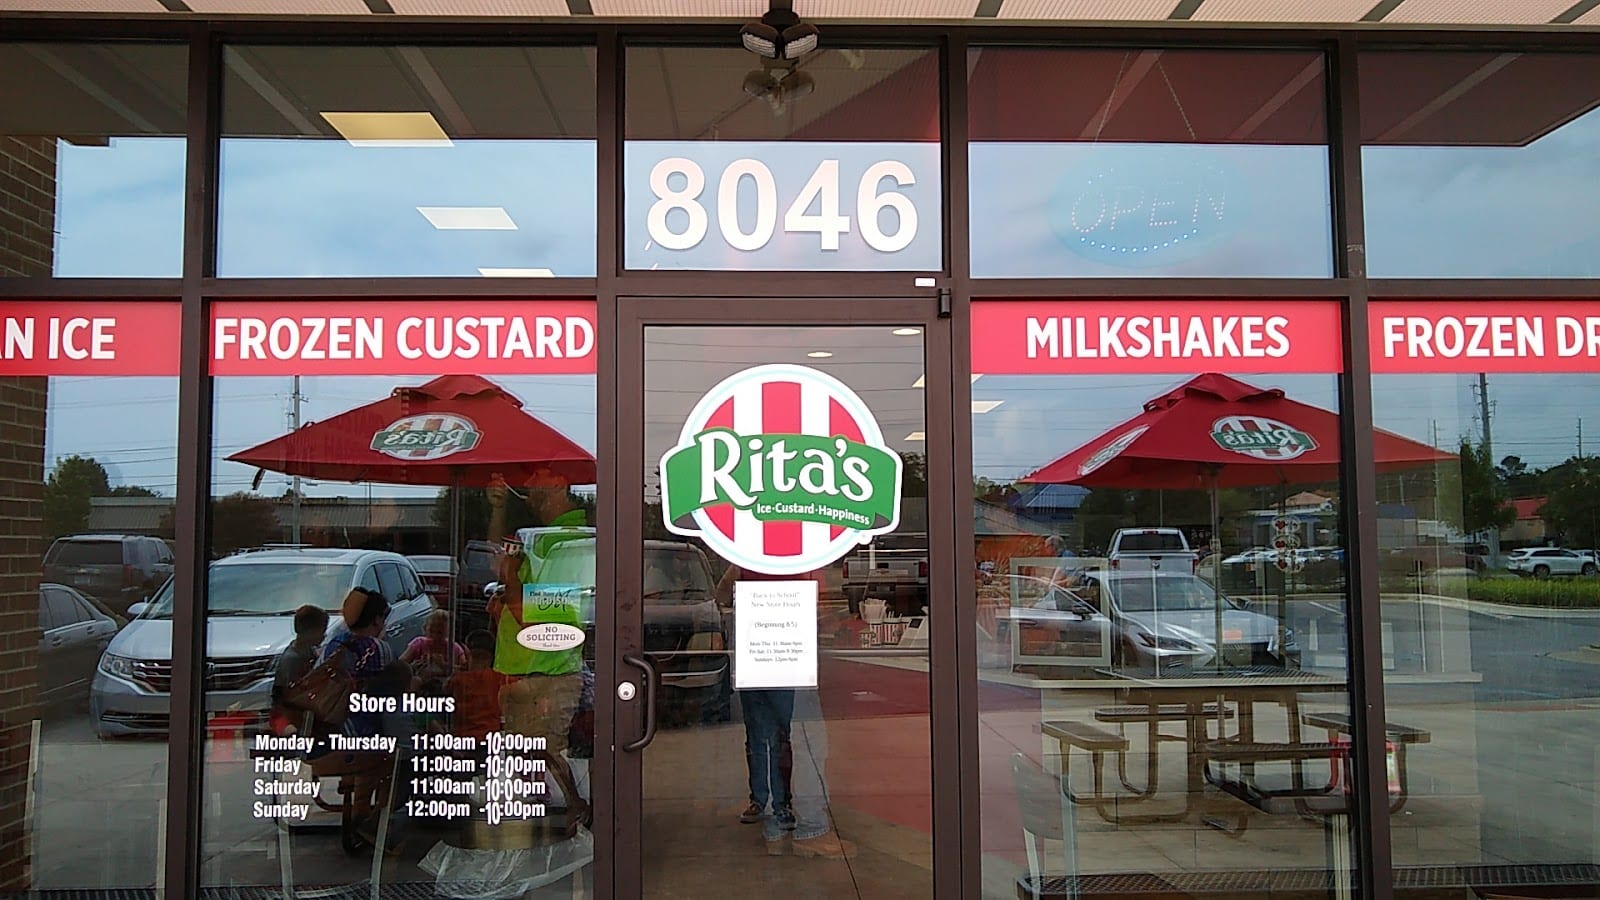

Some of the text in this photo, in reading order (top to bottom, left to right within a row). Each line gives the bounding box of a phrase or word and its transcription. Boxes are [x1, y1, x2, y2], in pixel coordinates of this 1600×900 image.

[647, 157, 918, 251] 8046
[1072, 180, 1227, 233] OPEN
[0, 317, 116, 360] N ICE
[214, 316, 594, 360] FROZEN CUSTARD
[1026, 316, 1290, 358] MILKSHAKES
[1383, 316, 1545, 358] FROZEN
[698, 429, 874, 507] Rita's
[754, 621, 784, 629] (Beginning
[349, 692, 456, 713] Store Hours
[255, 734, 315, 754] Monday
[329, 733, 397, 752] Thursday
[411, 734, 476, 750] 11:00am
[254, 756, 302, 775] Friday
[411, 756, 476, 772] 11:00am
[254, 779, 320, 798] Saturday
[410, 778, 475, 795] 11:00am
[253, 801, 309, 820] Sunday
[405, 800, 470, 820] 12:00pm
